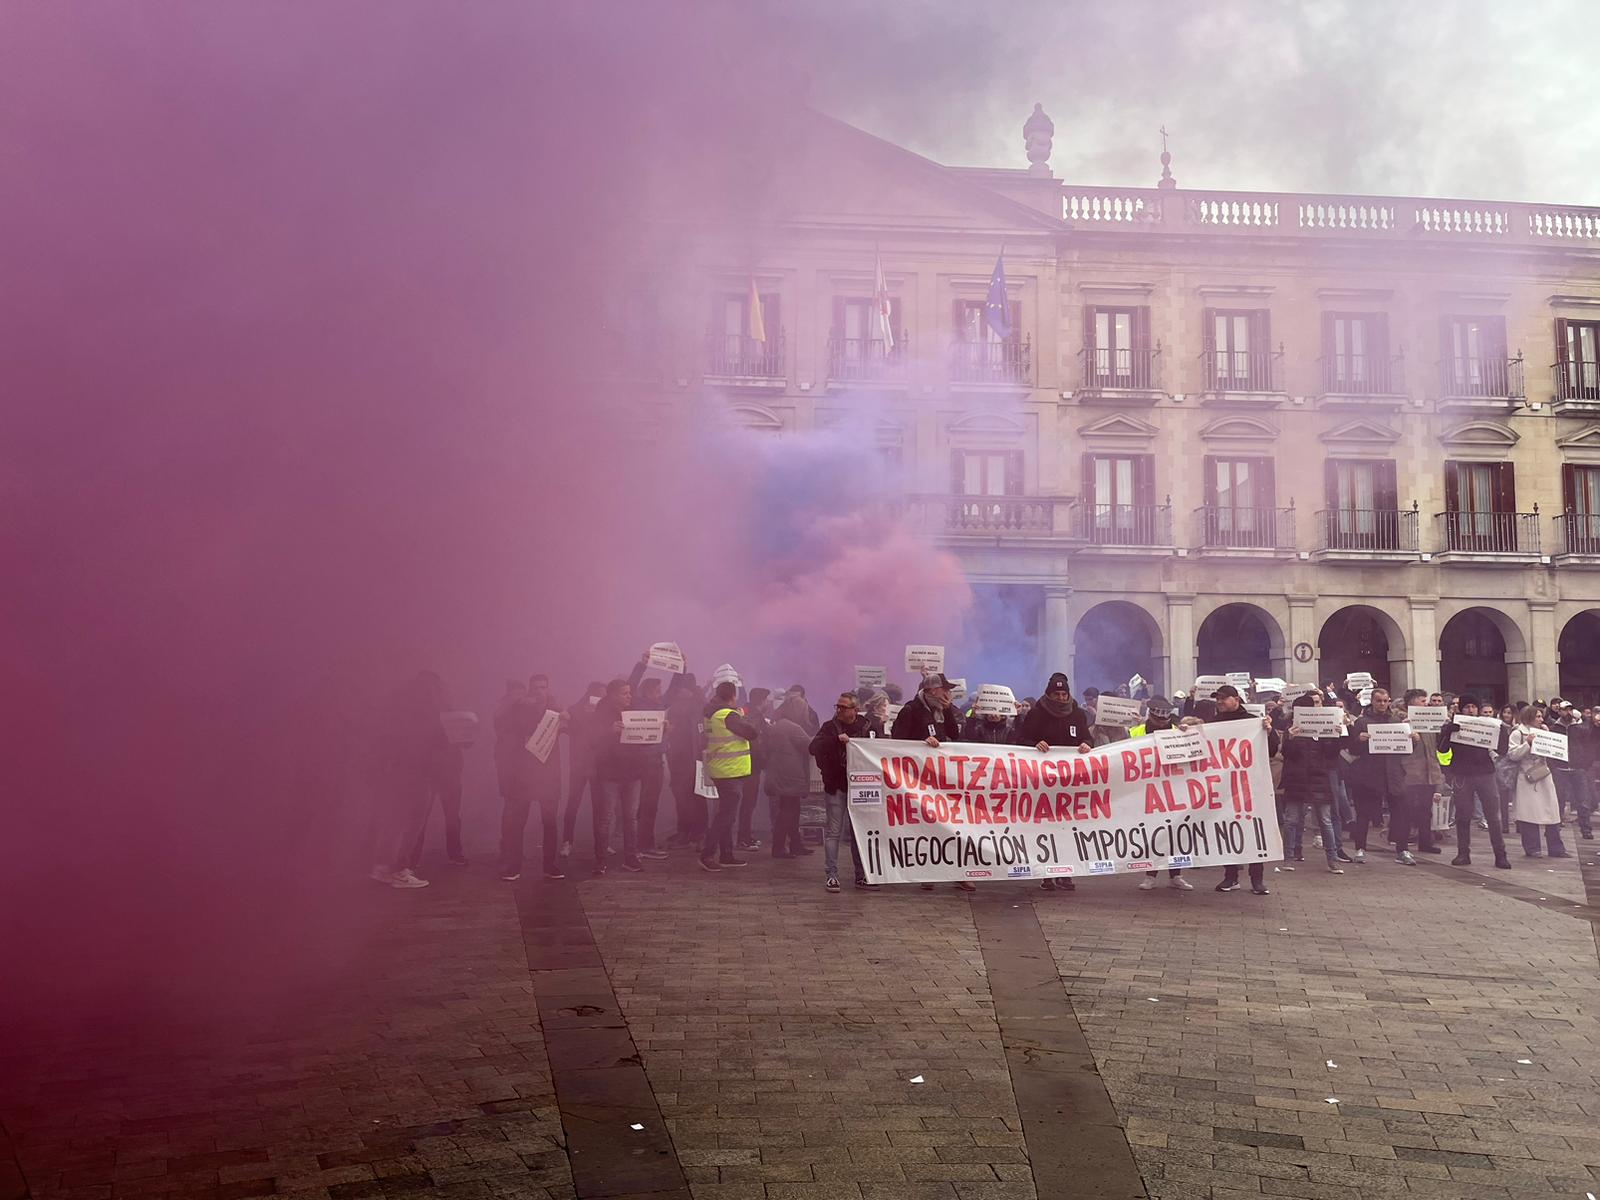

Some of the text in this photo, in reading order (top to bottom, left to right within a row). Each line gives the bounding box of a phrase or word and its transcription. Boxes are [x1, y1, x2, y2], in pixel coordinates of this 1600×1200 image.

[880, 737, 1253, 790] UDALTZAINGOAN BENAKO
[886, 788, 1112, 826] NEGOZIAZIOAREN
[889, 826, 1029, 868] NEGOCIACIÓN
[1036, 834, 1058, 863] SI
[1072, 815, 1209, 861] IMPOSICIÓN
[1214, 821, 1244, 855] NO
[1253, 817, 1267, 857] !!
